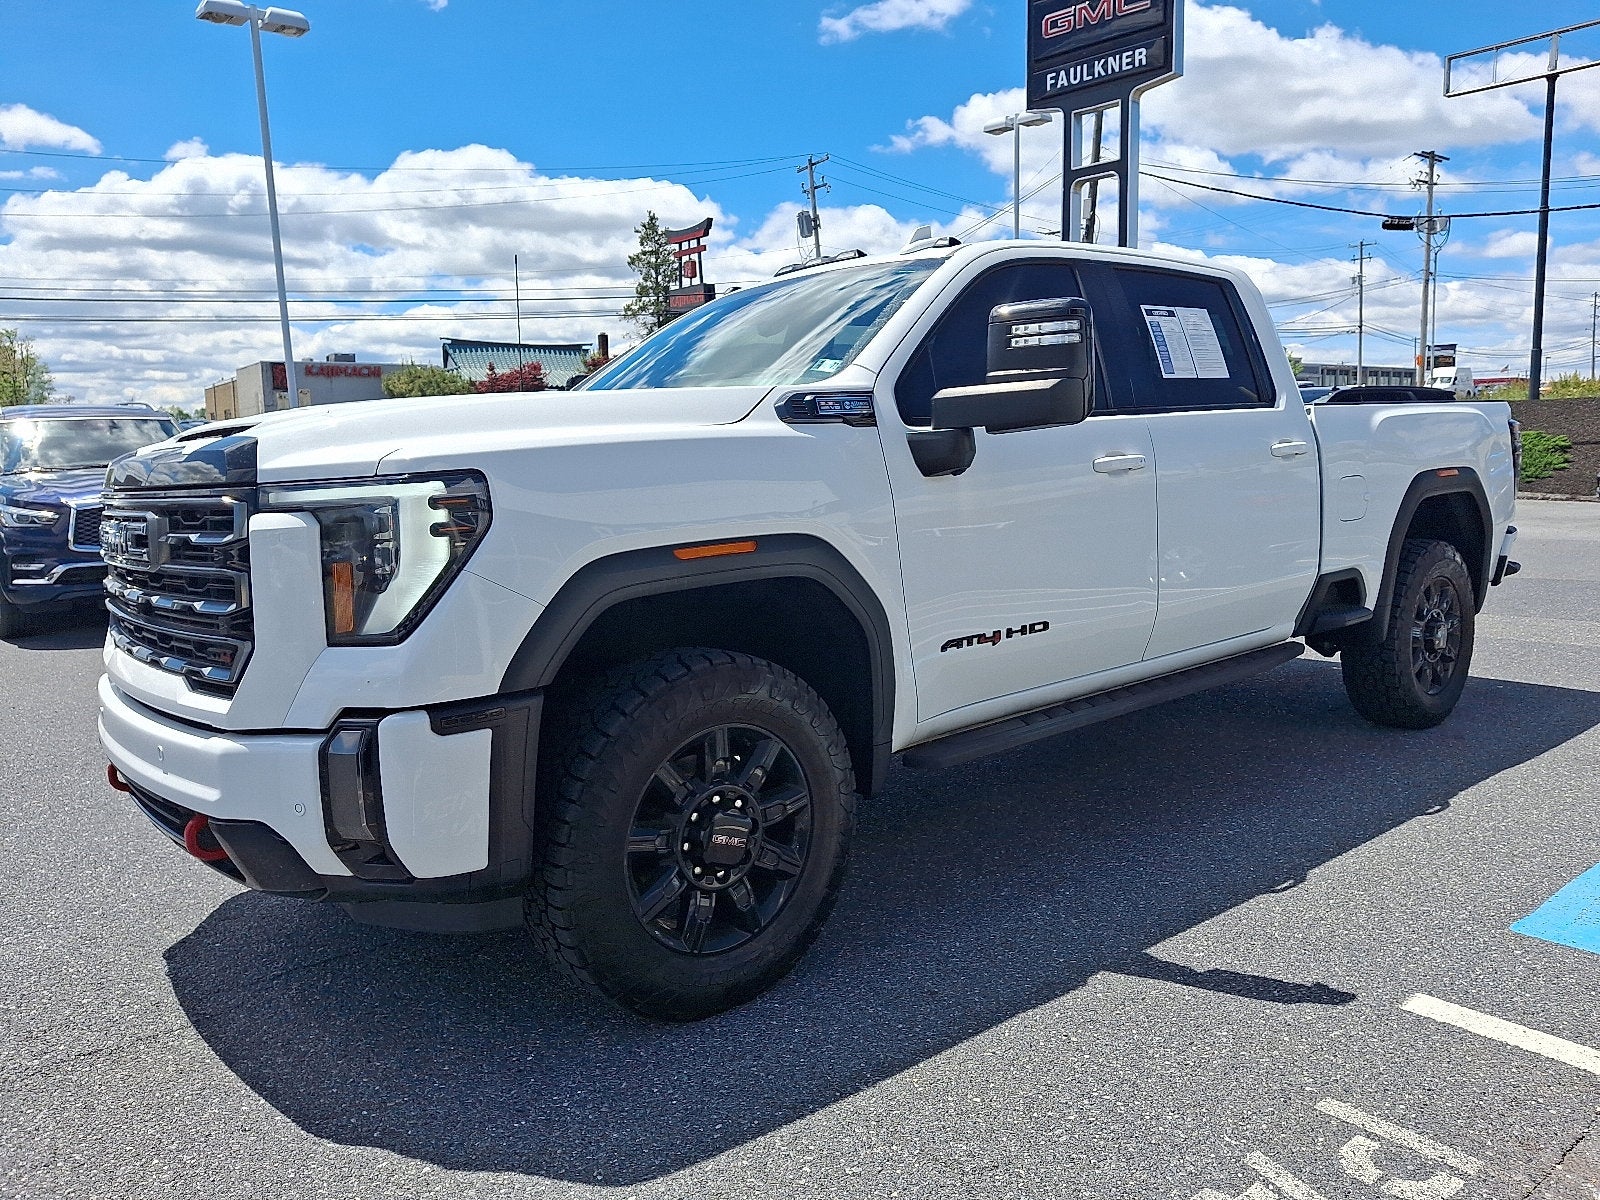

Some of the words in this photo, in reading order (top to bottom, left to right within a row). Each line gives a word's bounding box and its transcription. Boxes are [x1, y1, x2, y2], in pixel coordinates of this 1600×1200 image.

[1042, 0, 1151, 39] GMC
[1046, 47, 1148, 92] FAULKNER
[940, 630, 1002, 652] AT4
[1005, 620, 1050, 639] HD
[711, 834, 747, 848] GMC
